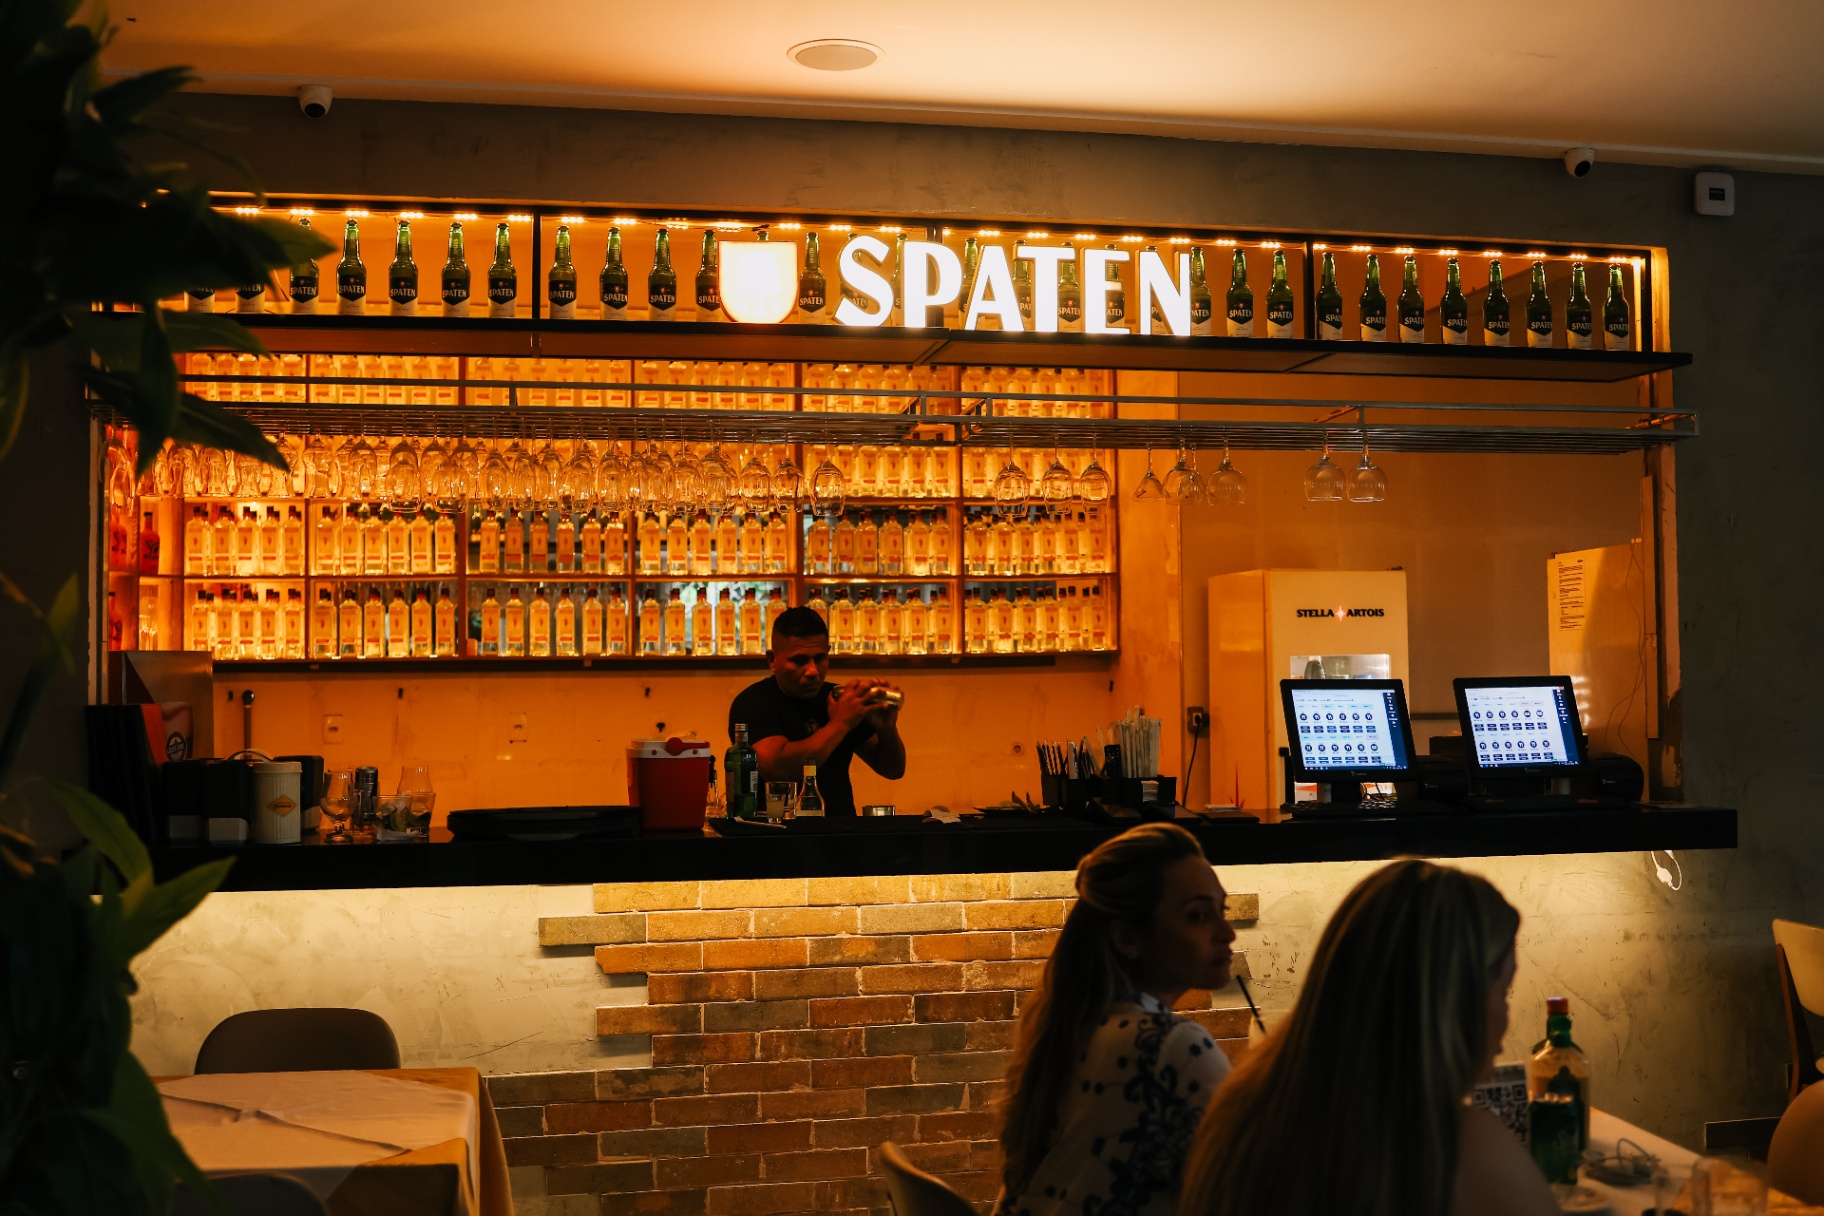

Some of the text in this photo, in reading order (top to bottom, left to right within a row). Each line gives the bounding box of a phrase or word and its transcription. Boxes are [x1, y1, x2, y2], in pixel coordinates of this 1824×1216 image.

[339, 284, 365, 294] SPATEN
[835, 235, 1191, 336] SPATEN
[290, 286, 318, 296] SPATEN
[390, 288, 416, 297] SPATEN
[442, 288, 467, 298] SPATEN
[488, 288, 514, 298] SPATEN
[549, 290, 575, 300] SPATEN
[650, 293, 675, 304] SPATEN
[698, 295, 720, 305] SPATE
[799, 296, 824, 306] SPATEN
[1107, 308, 1123, 317] ATEN
[1190, 309, 1210, 318] PATEN
[1269, 311, 1293, 320] SPATEN
[1365, 316, 1386, 325] SPATE
[1404, 316, 1424, 326] SPATE
[1296, 608, 1385, 618] STELLA ARTOIS
